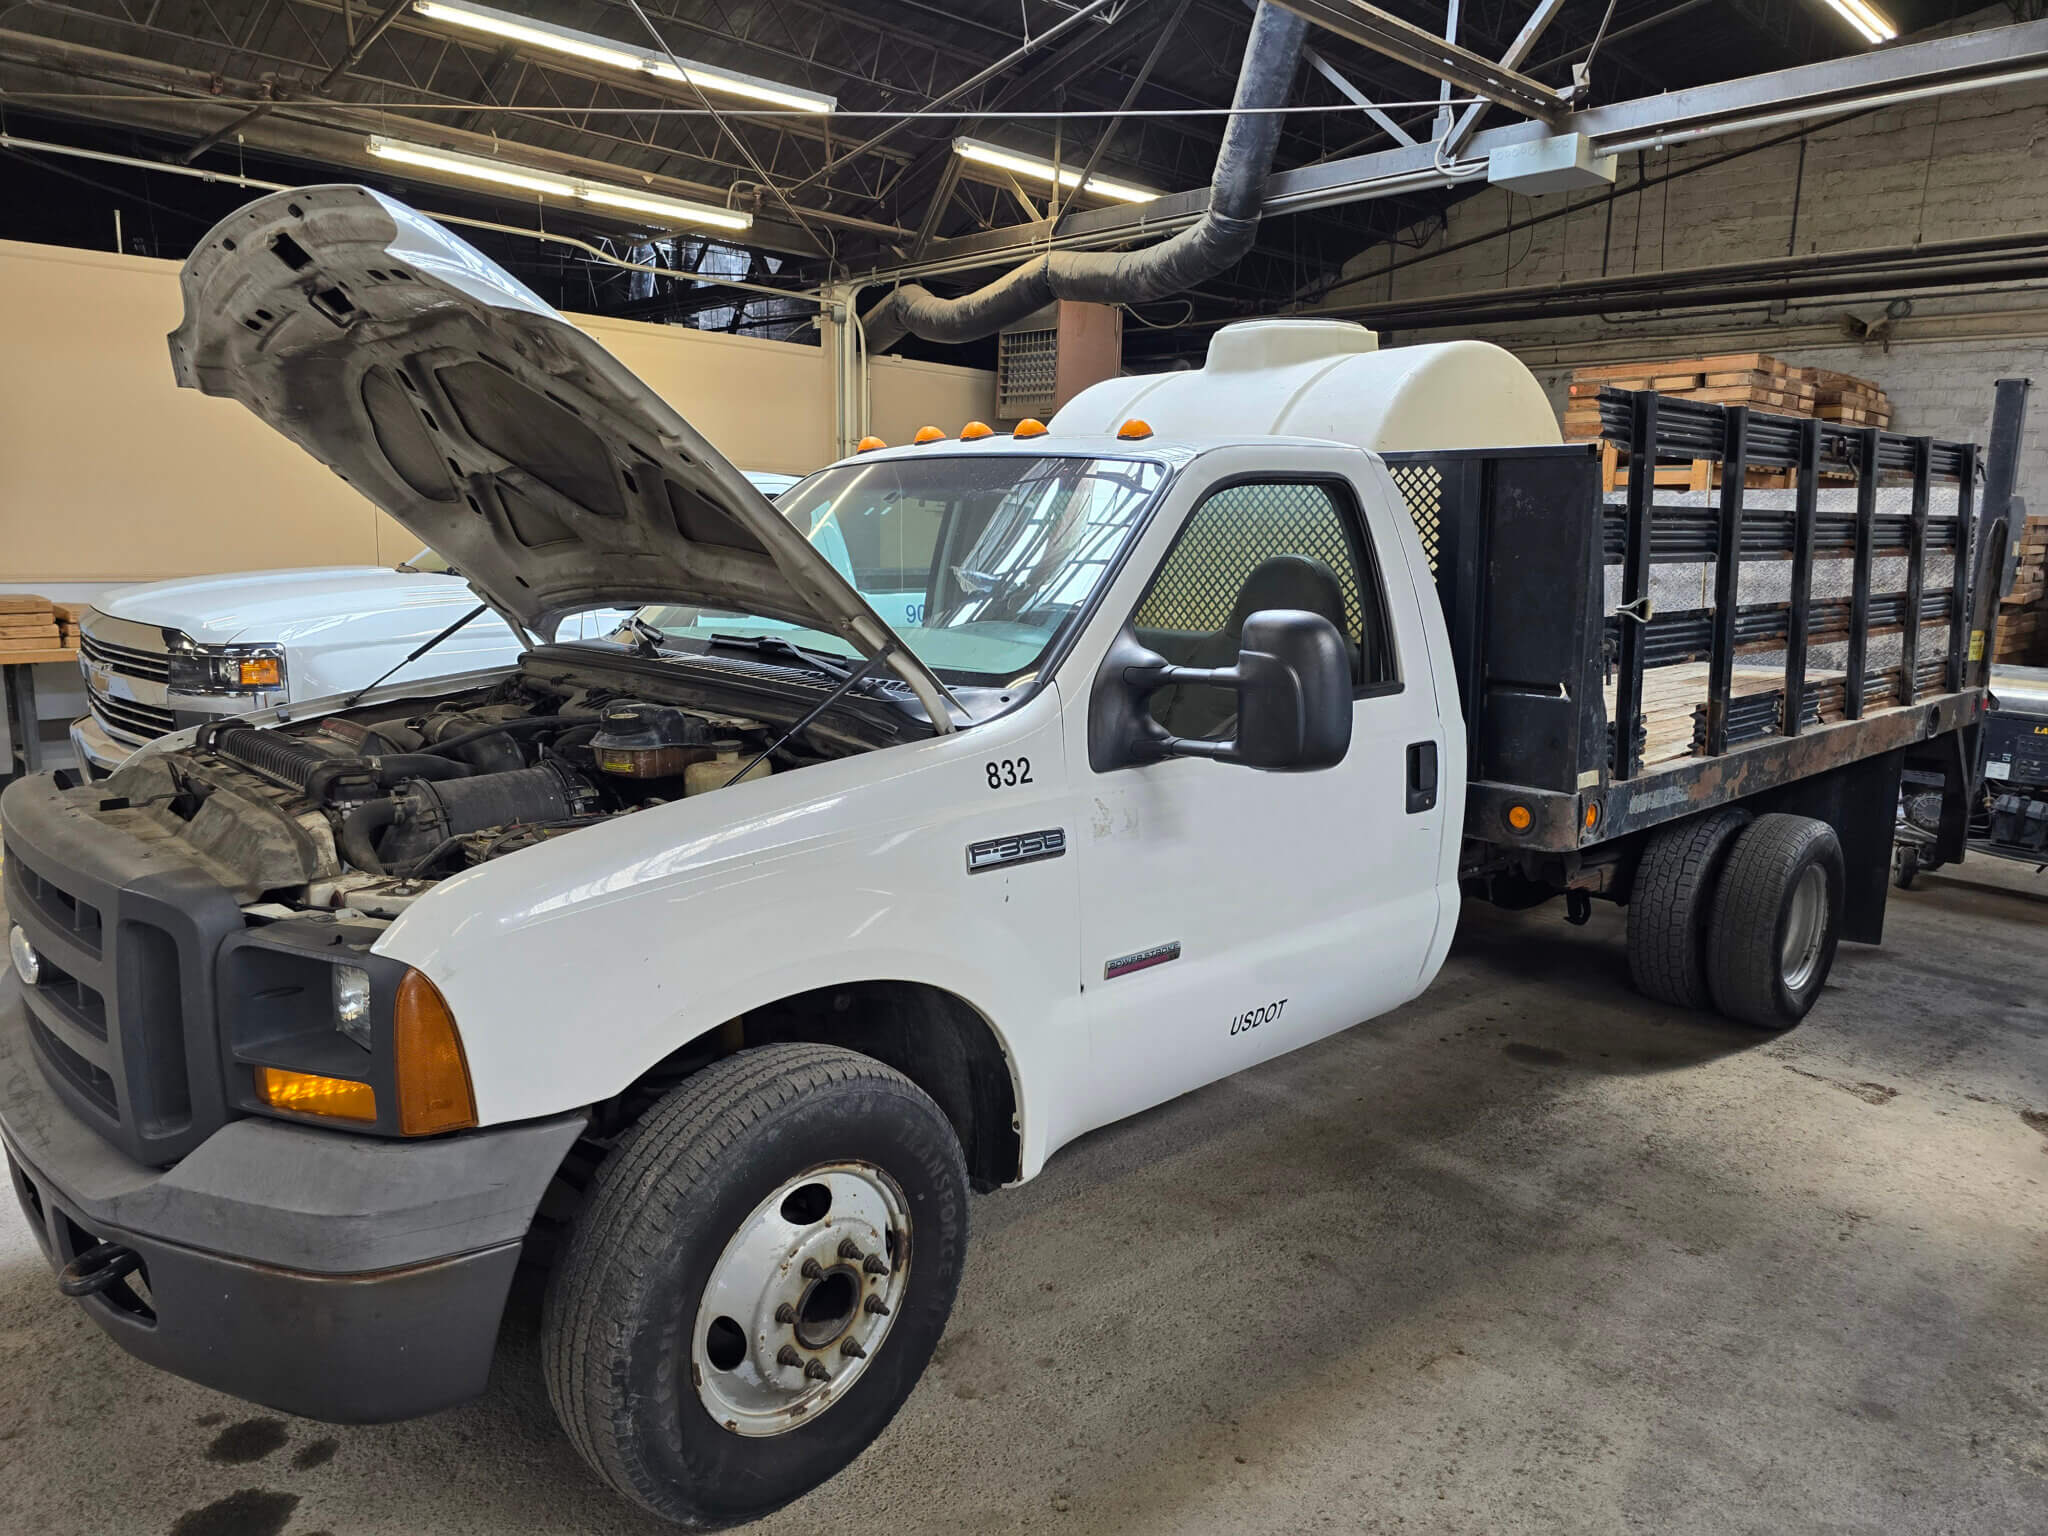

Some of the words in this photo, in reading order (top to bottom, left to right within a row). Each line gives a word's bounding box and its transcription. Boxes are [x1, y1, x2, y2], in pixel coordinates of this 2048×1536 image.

[986, 757, 1033, 789] 832
[969, 829, 1065, 864] F-350
[1230, 998, 1288, 1036] USDOT
